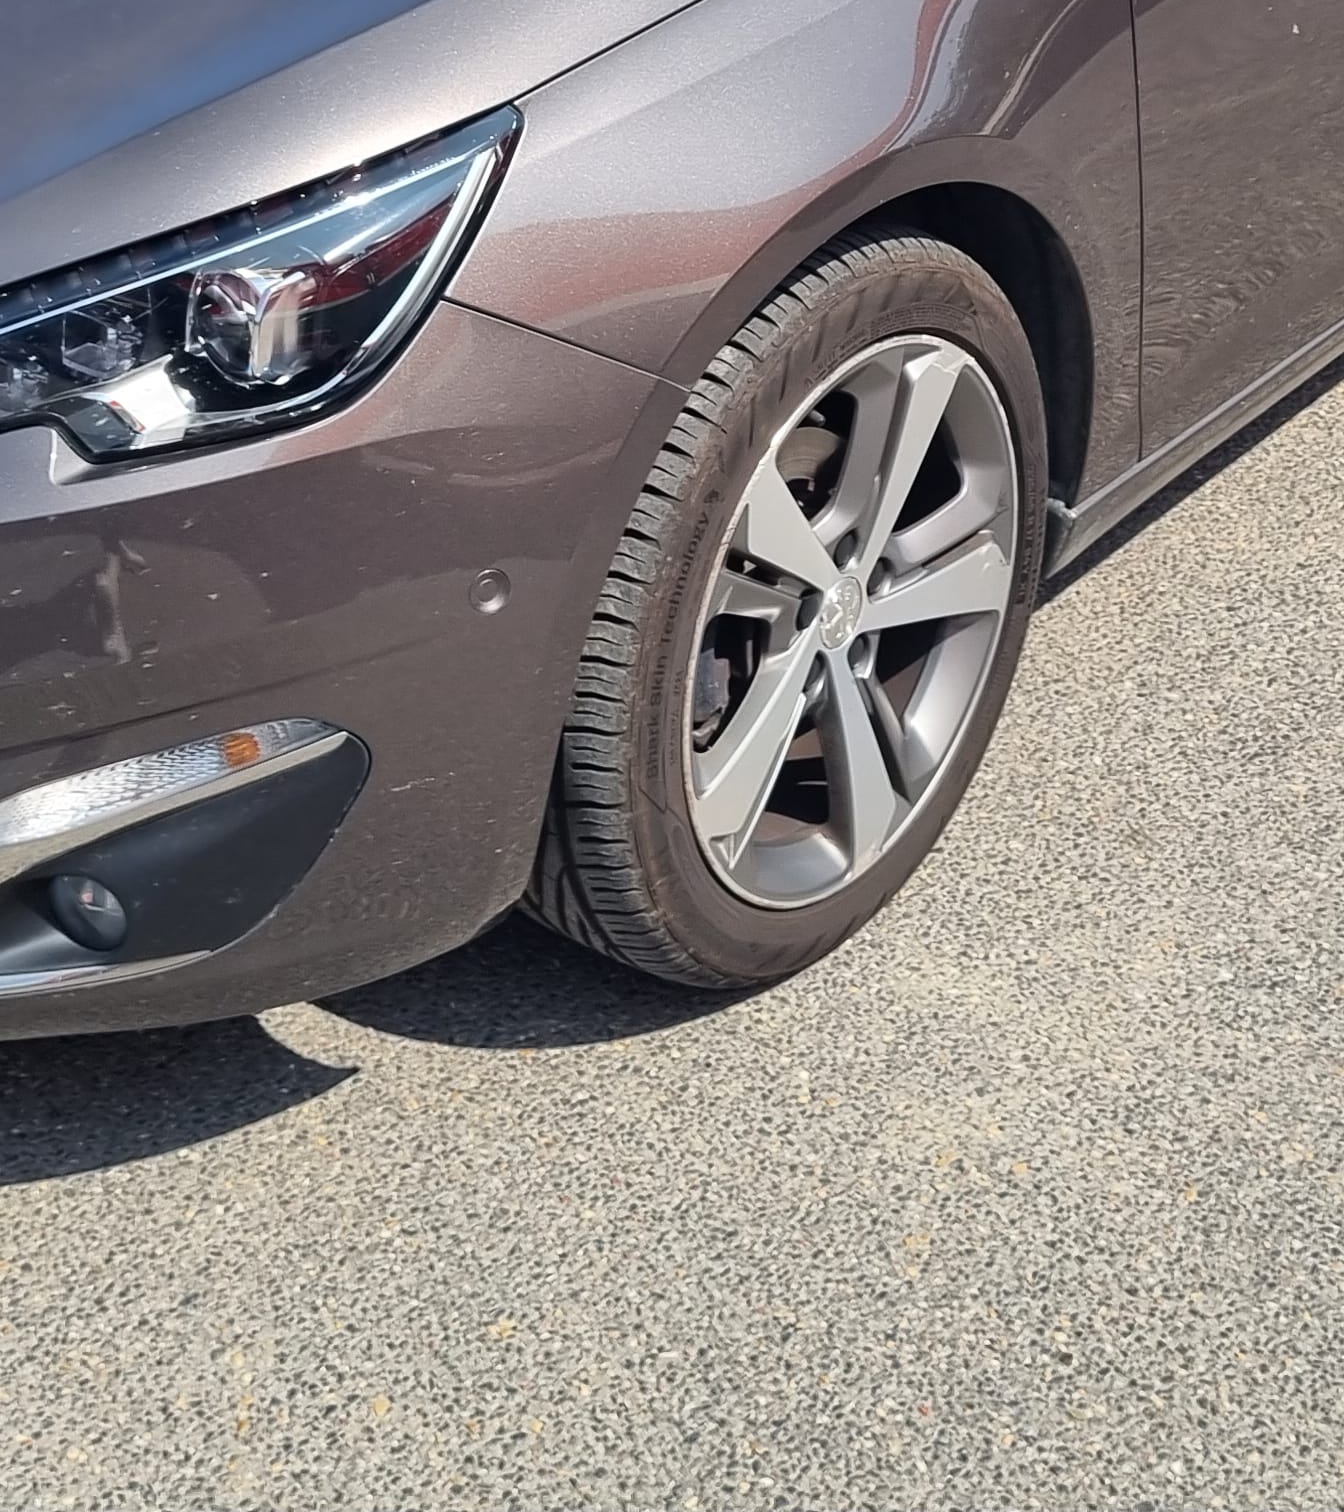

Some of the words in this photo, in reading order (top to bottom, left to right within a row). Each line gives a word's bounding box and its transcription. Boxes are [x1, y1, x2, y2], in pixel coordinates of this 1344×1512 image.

[660, 511, 709, 643] Technology
[650, 655, 669, 707] Skin
[646, 714, 659, 780] Shark
